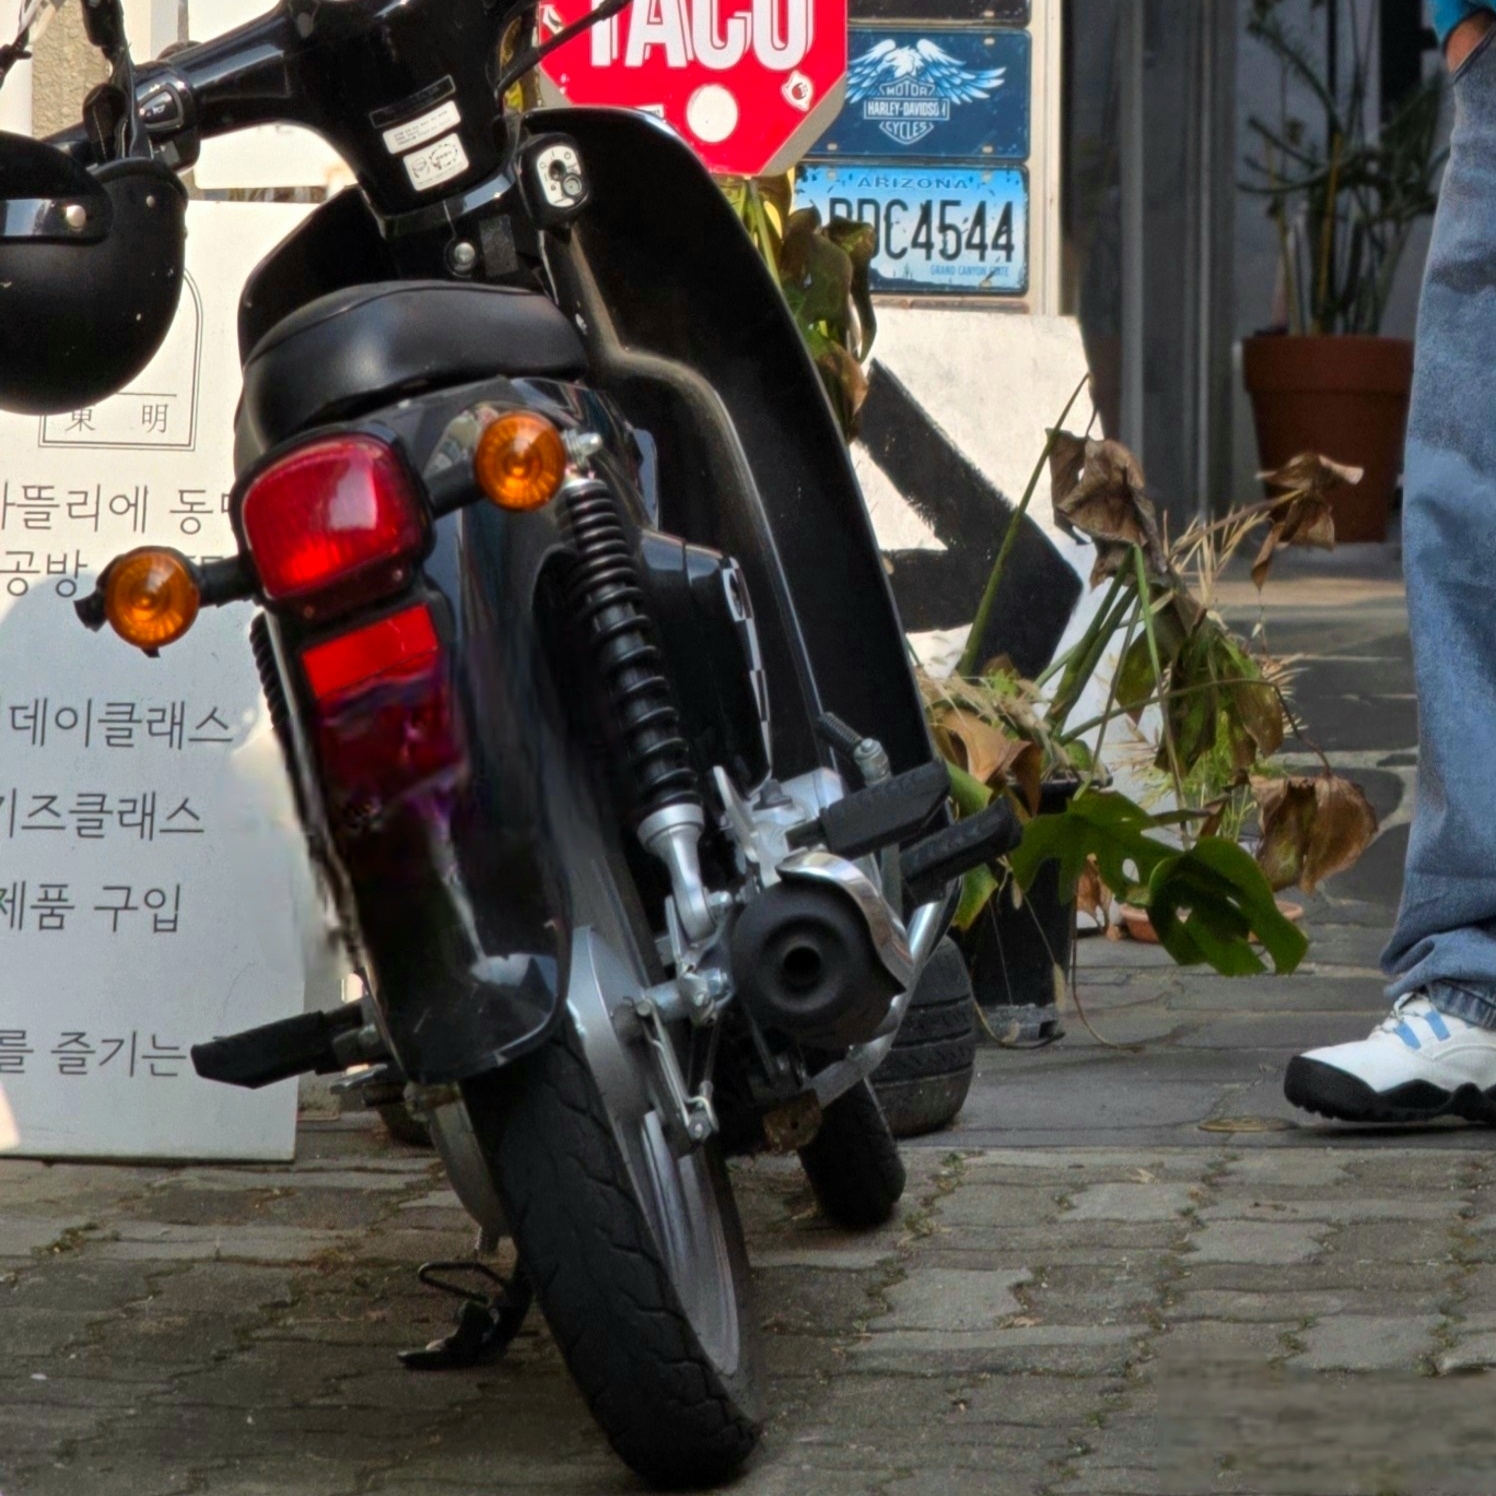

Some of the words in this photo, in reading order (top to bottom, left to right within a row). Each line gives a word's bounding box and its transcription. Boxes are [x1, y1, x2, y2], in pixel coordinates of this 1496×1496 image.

[886, 81, 928, 96] MOTOR
[885, 121, 927, 139] CYCLES
[858, 176, 968, 189] ARIZONA
[930, 265, 955, 276] GRAND
[958, 266, 986, 276] CANYON
[94, 883, 182, 933] 구입
[50, 1030, 186, 1077] 즐기는
